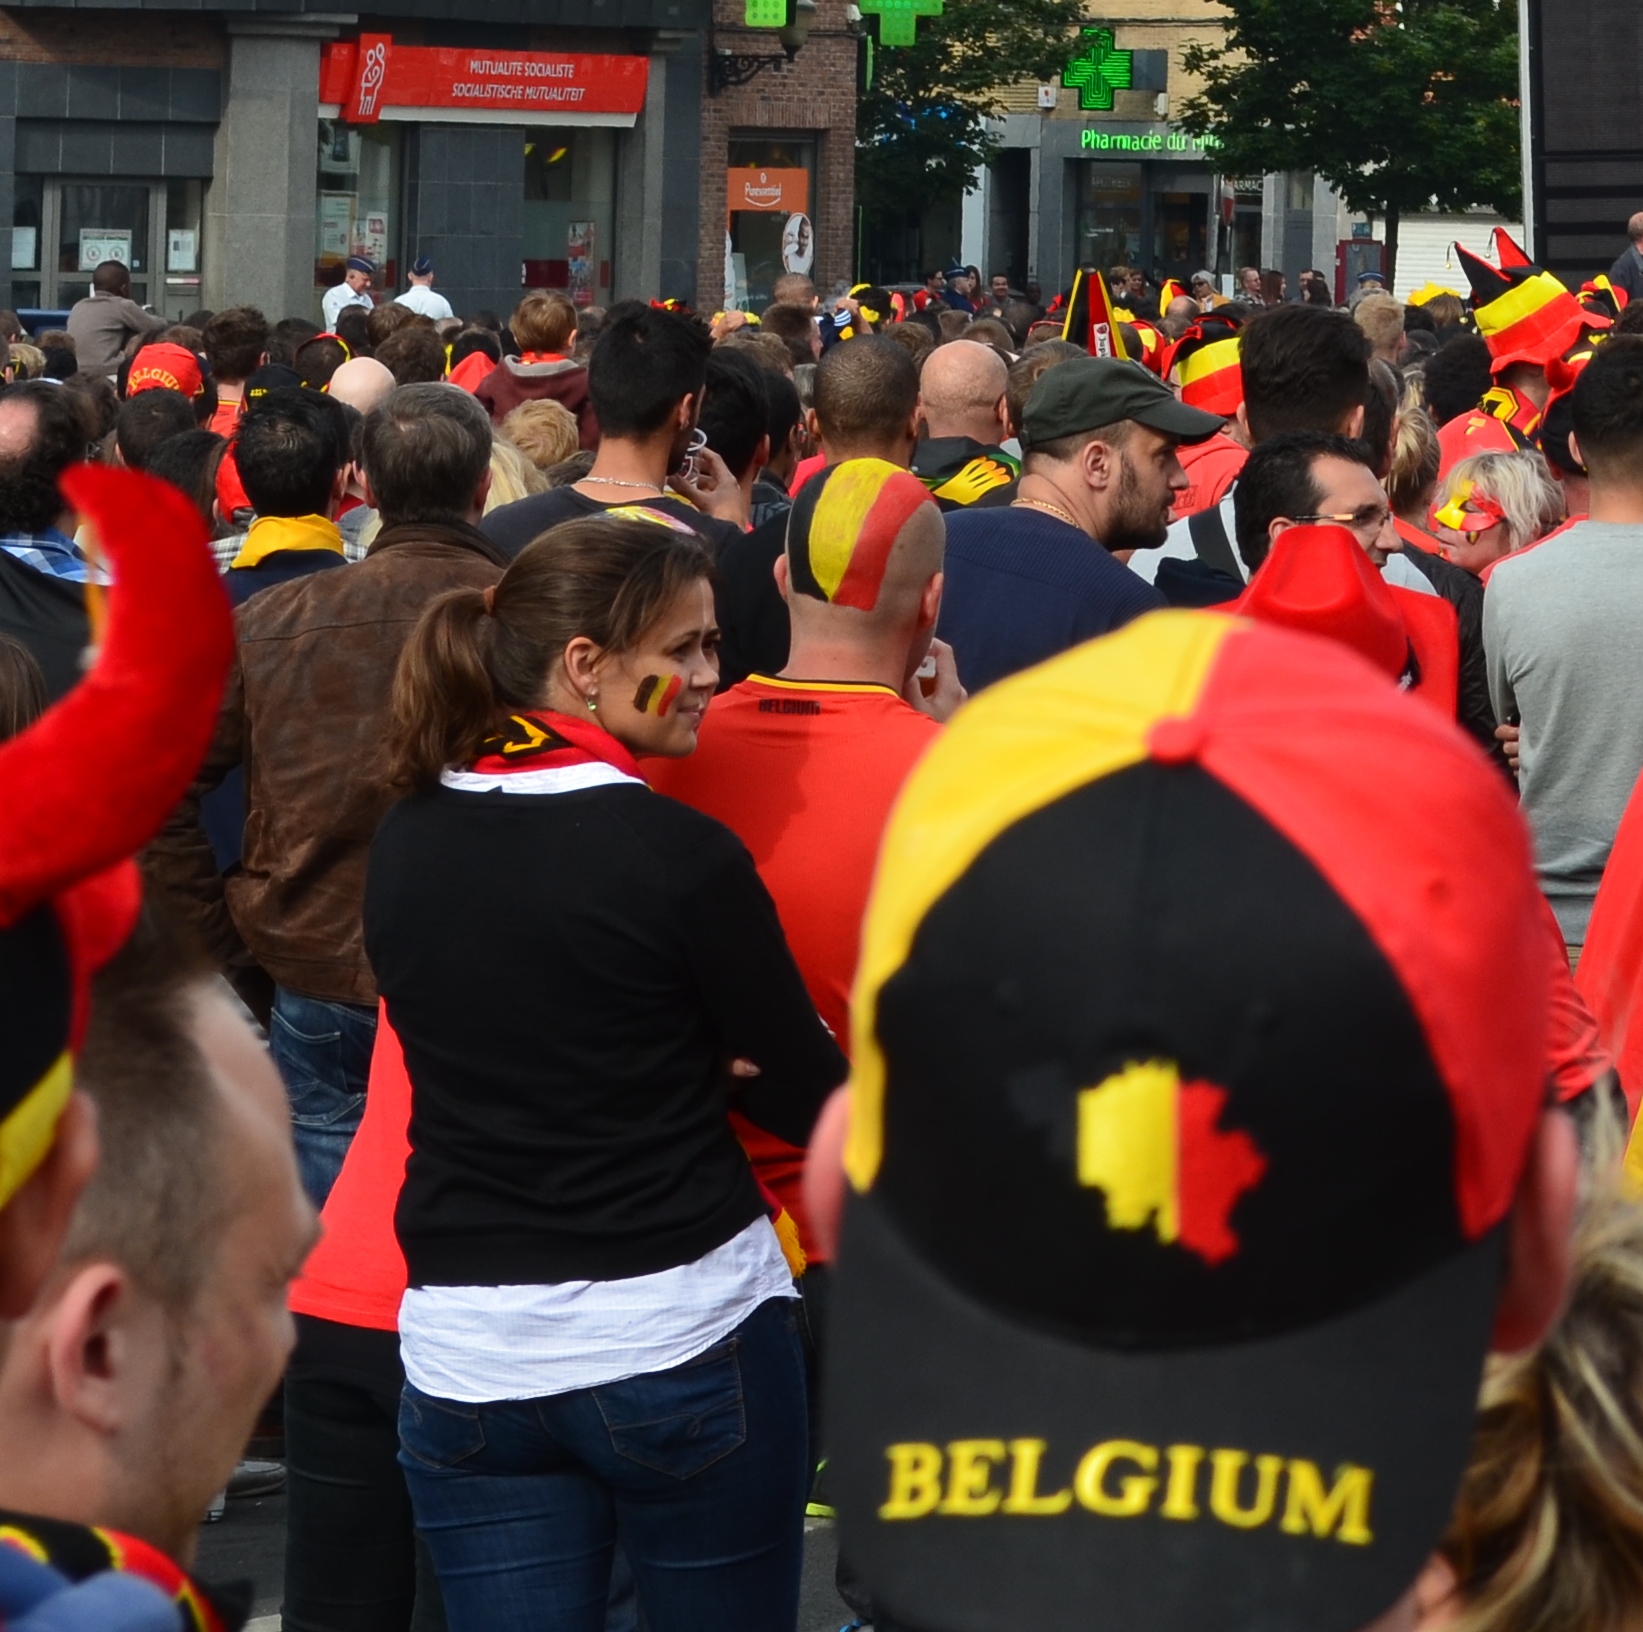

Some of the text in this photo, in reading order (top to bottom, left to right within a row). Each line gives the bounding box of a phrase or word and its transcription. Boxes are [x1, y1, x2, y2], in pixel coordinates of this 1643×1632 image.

[524, 61, 575, 79] SOCIALISTE
[451, 82, 586, 102] SOCIALISTISCHE MUTUALITEIT
[1081, 128, 1162, 152] Pharmacie
[1166, 131, 1187, 152] du
[877, 1436, 1375, 1546] BELGIUM
